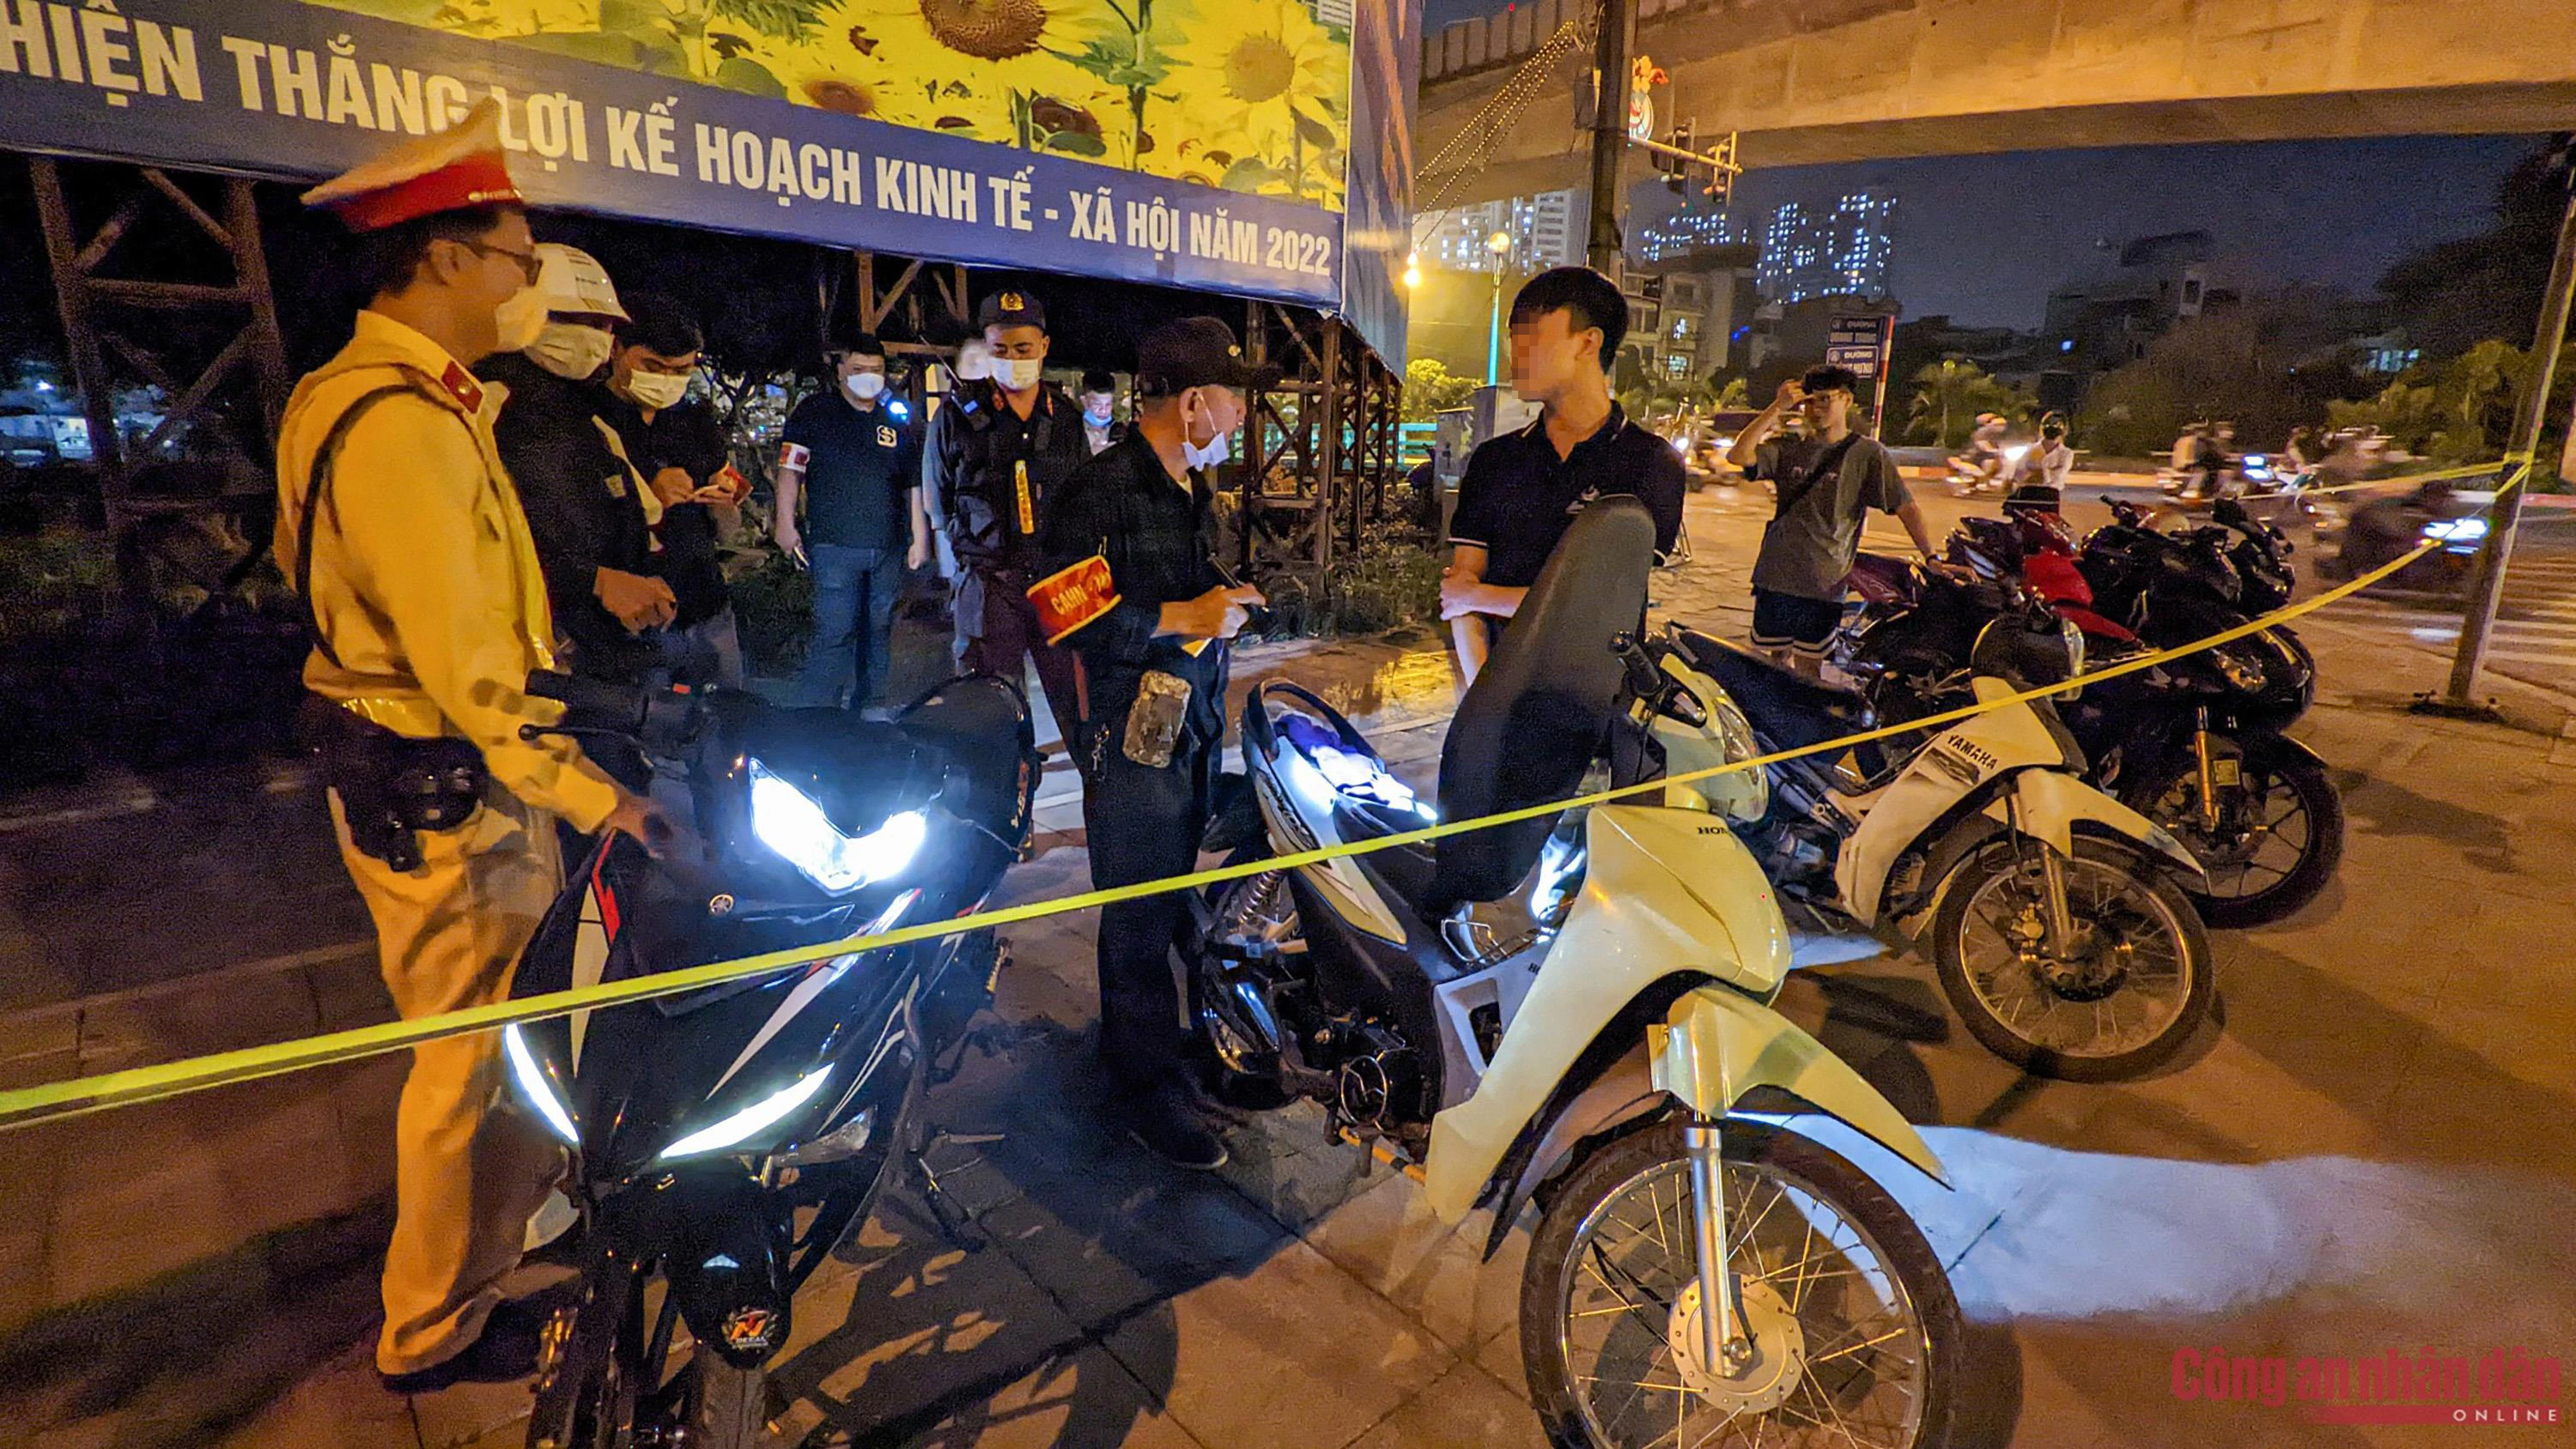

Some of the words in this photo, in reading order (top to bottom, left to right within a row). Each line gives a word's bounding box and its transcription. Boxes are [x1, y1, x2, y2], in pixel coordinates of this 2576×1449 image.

[0, 0, 204, 107] HIỆN
[490, 85, 590, 173] LỢI
[605, 96, 680, 177] KẾ
[695, 123, 862, 207] HOẠCH
[875, 156, 978, 224] KINH
[987, 166, 1034, 232] TẾ
[1069, 186, 1118, 244] XÃ
[1126, 197, 1181, 261] HỘI
[1189, 209, 1260, 274] NĂM
[1266, 227, 1332, 277] 2022
[1947, 735, 1998, 769] YAMAHA
